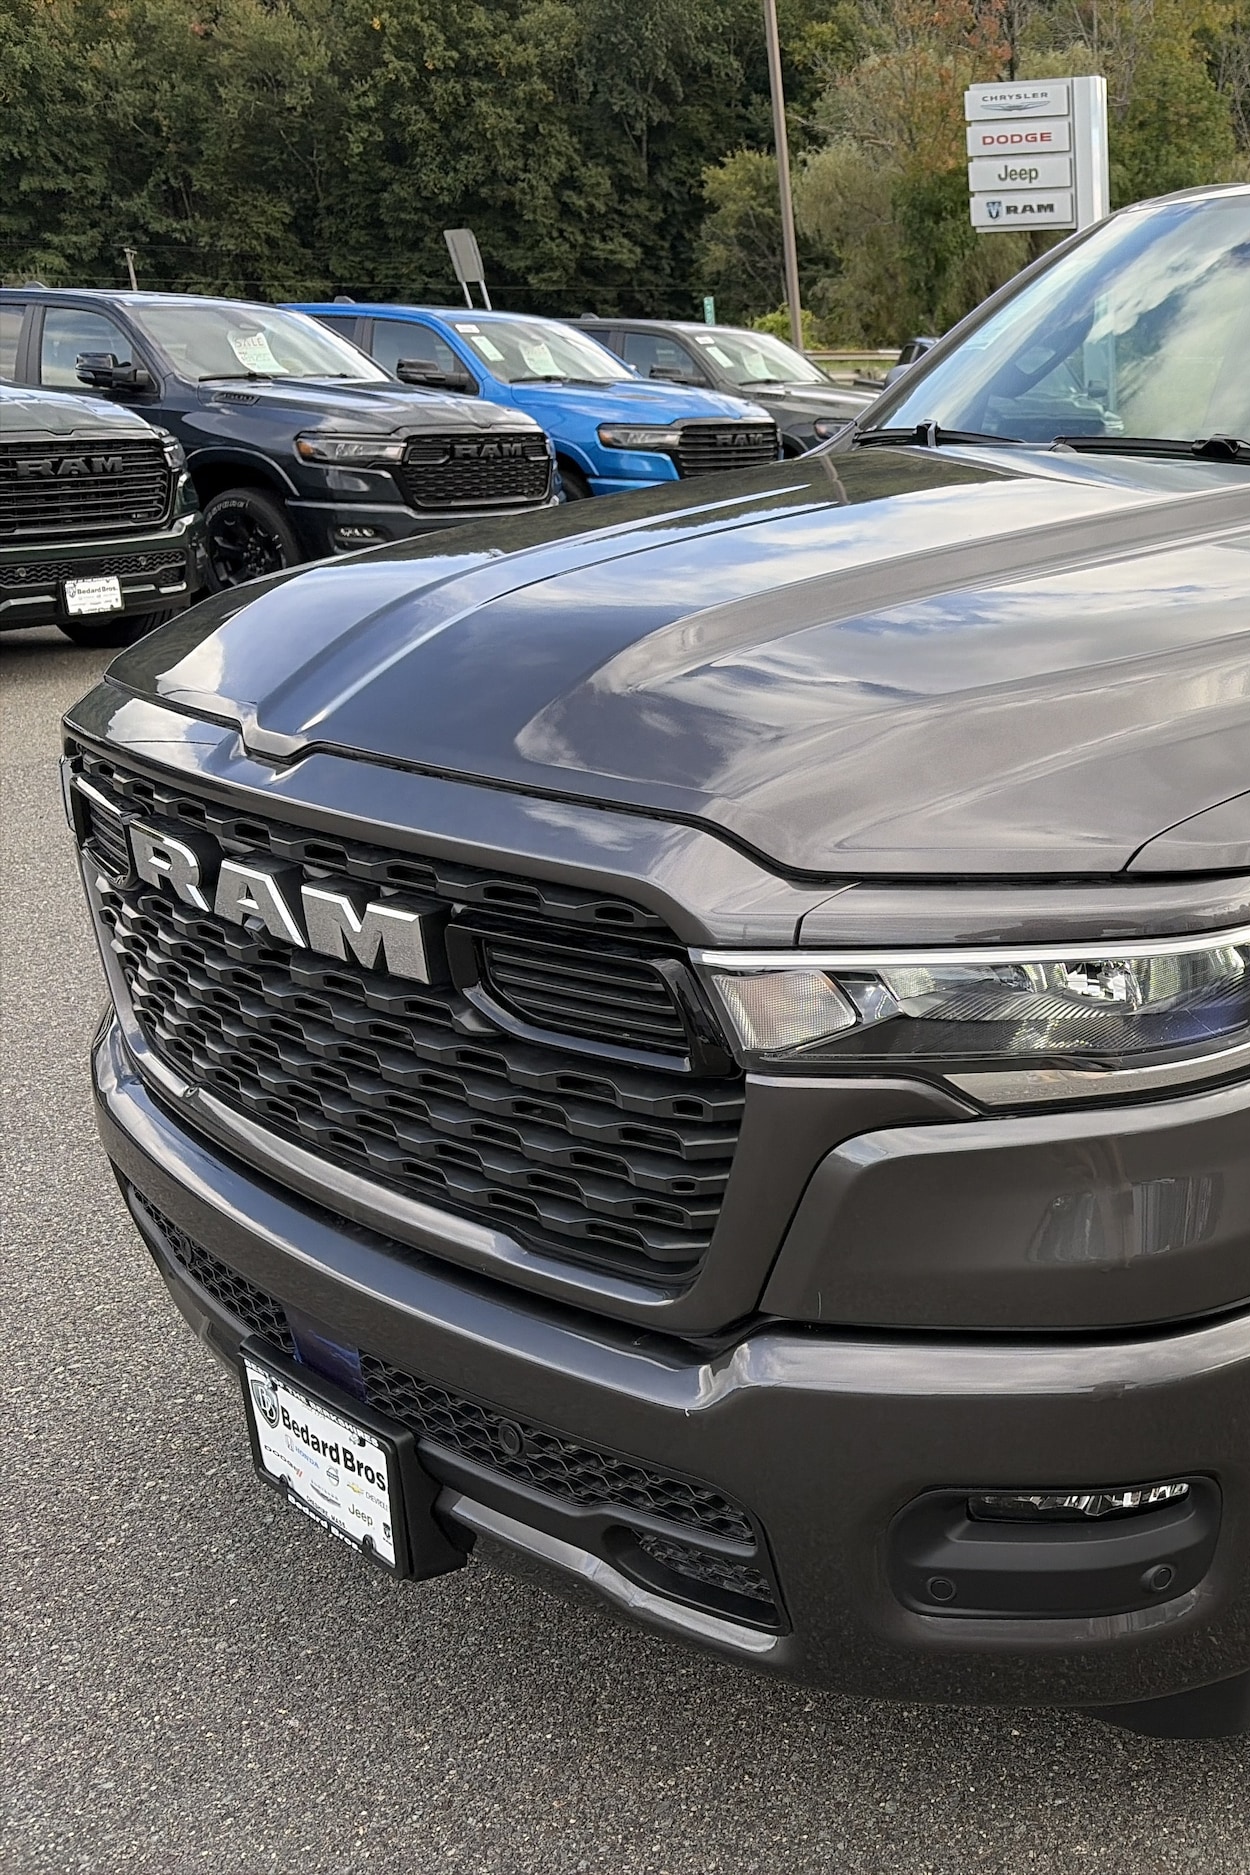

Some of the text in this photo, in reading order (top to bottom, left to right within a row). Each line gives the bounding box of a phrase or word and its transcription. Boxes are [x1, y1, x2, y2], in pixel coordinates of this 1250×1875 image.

[982, 92, 1048, 102] CHRYSLER
[982, 132, 1052, 146] DODGE
[997, 164, 1039, 184] Jeep
[1005, 203, 1055, 215] RAM
[716, 434, 763, 446] RAM
[454, 443, 522, 458] RAM
[16, 456, 123, 476] RAM
[129, 817, 431, 985] RAM
[281, 1405, 340, 1465] Bedard
[295, 1446, 320, 1469] HONDA
[287, 1493, 363, 1554] Bedard Bros.
[348, 1504, 373, 1527] Jeep
